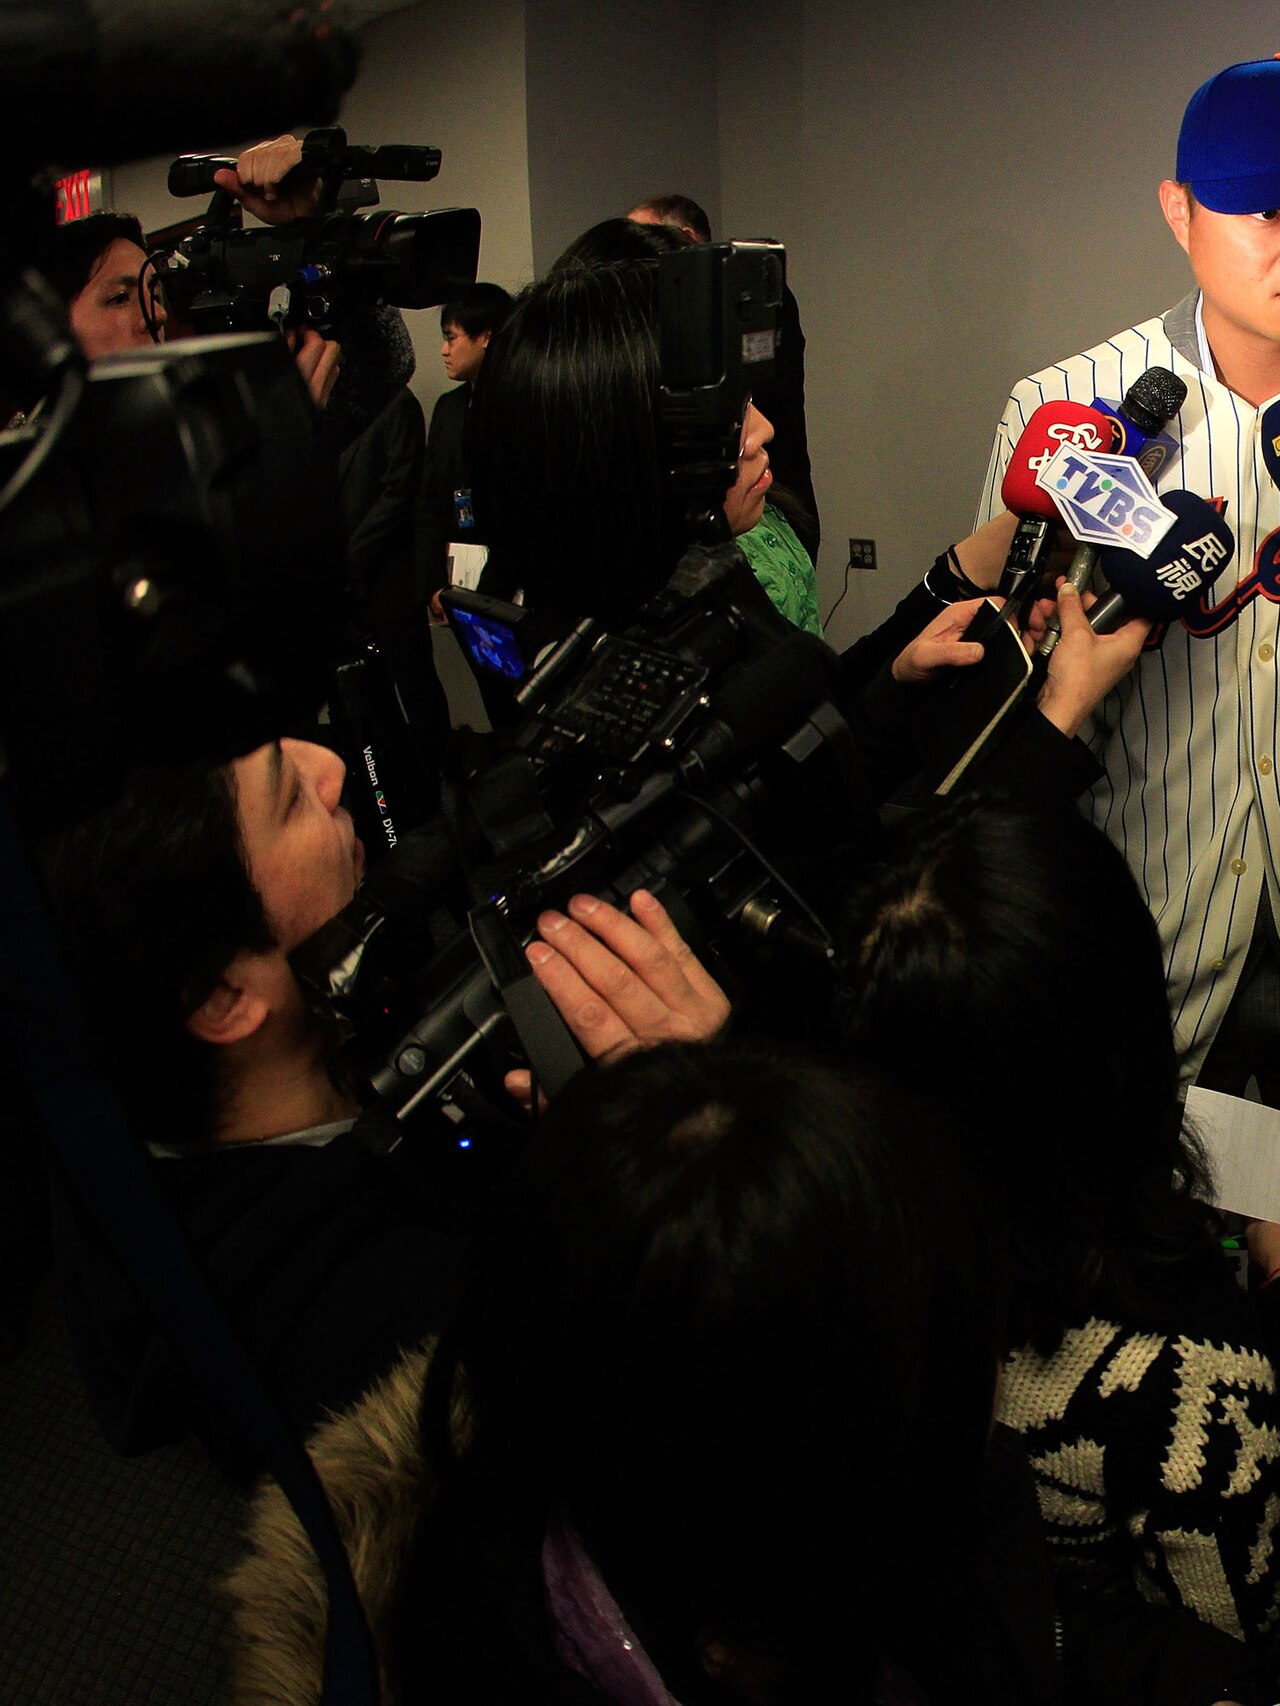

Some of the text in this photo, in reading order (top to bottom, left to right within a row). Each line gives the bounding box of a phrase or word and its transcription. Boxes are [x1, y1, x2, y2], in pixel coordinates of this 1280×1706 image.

[1062, 455, 1162, 544] TVBS
[1156, 532, 1228, 601] 民視
[363, 745, 379, 787] Velbon
